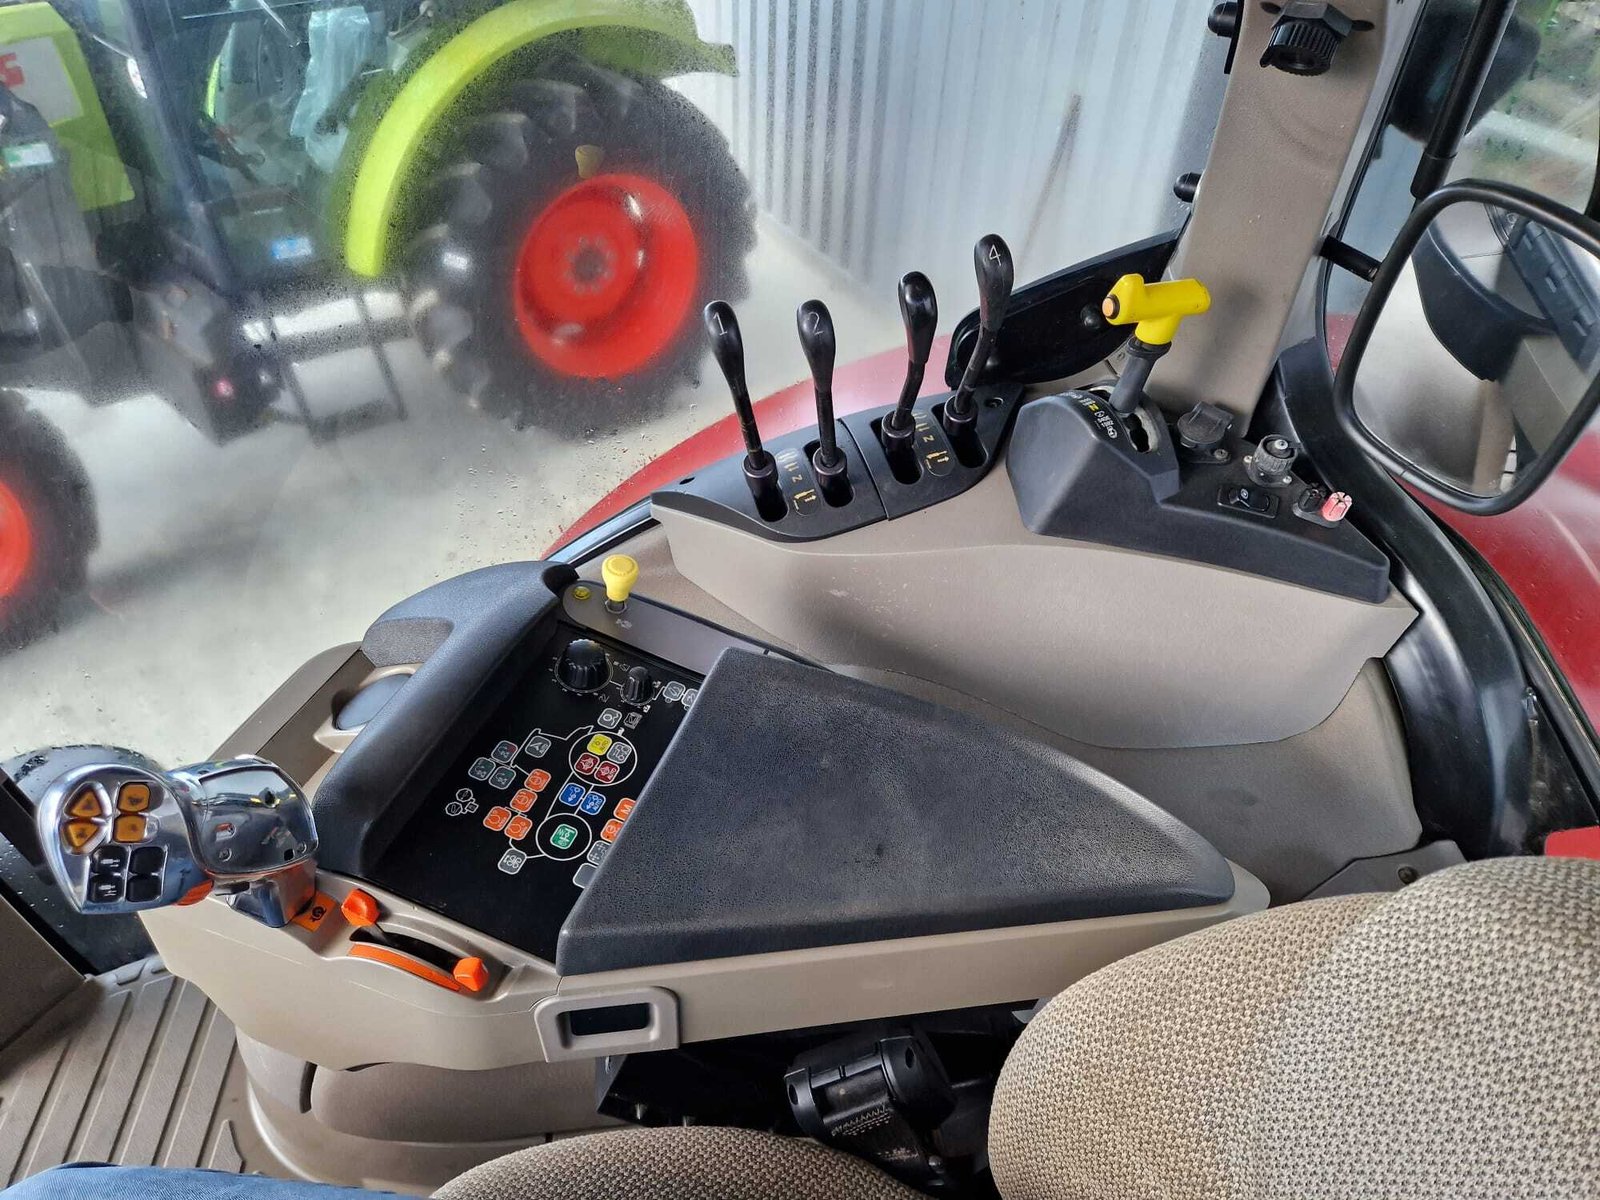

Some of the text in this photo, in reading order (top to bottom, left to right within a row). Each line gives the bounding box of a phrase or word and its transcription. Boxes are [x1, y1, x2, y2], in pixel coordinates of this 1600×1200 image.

[989, 244, 1002, 266] 4
[713, 312, 727, 335] 1
[809, 311, 824, 335] 2
